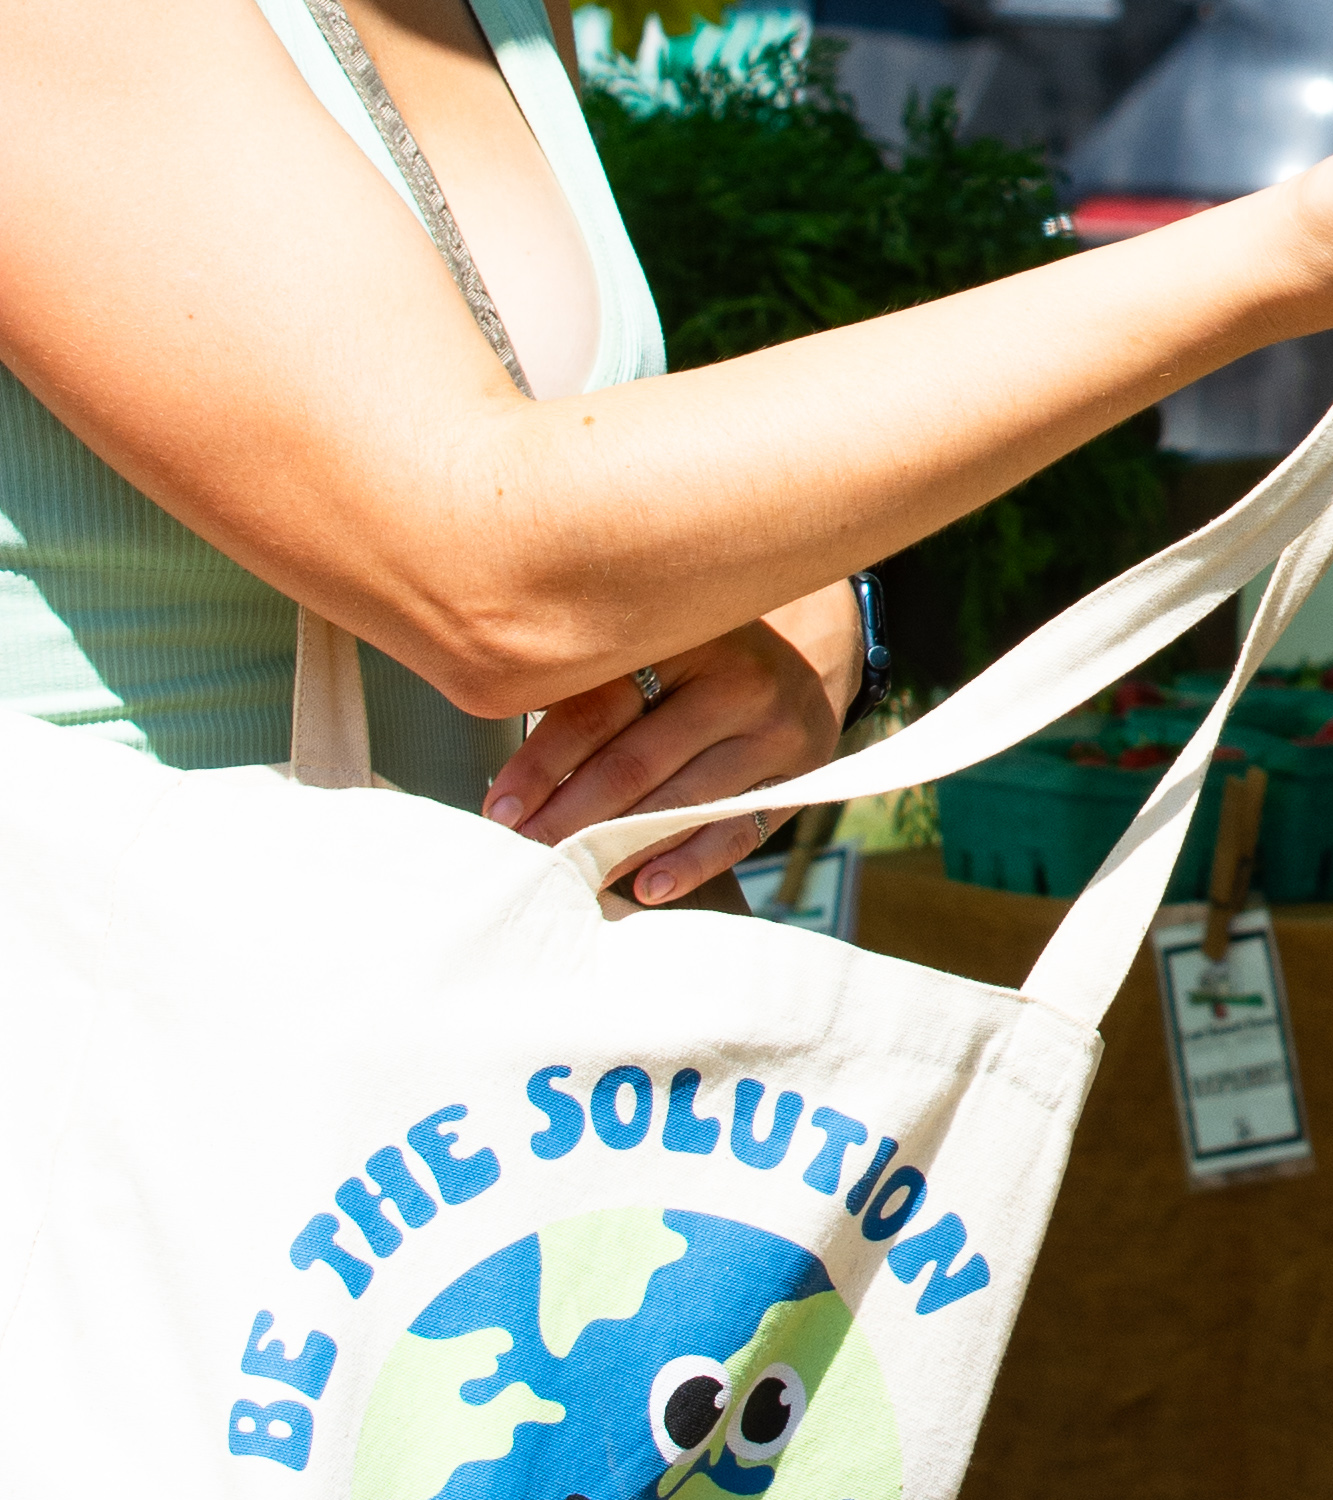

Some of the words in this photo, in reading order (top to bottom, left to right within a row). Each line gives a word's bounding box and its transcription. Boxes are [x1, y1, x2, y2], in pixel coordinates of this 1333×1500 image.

[227, 1309, 338, 1471] BE
[289, 1103, 501, 1299] THE
[525, 1064, 991, 1316] SOLUTION
